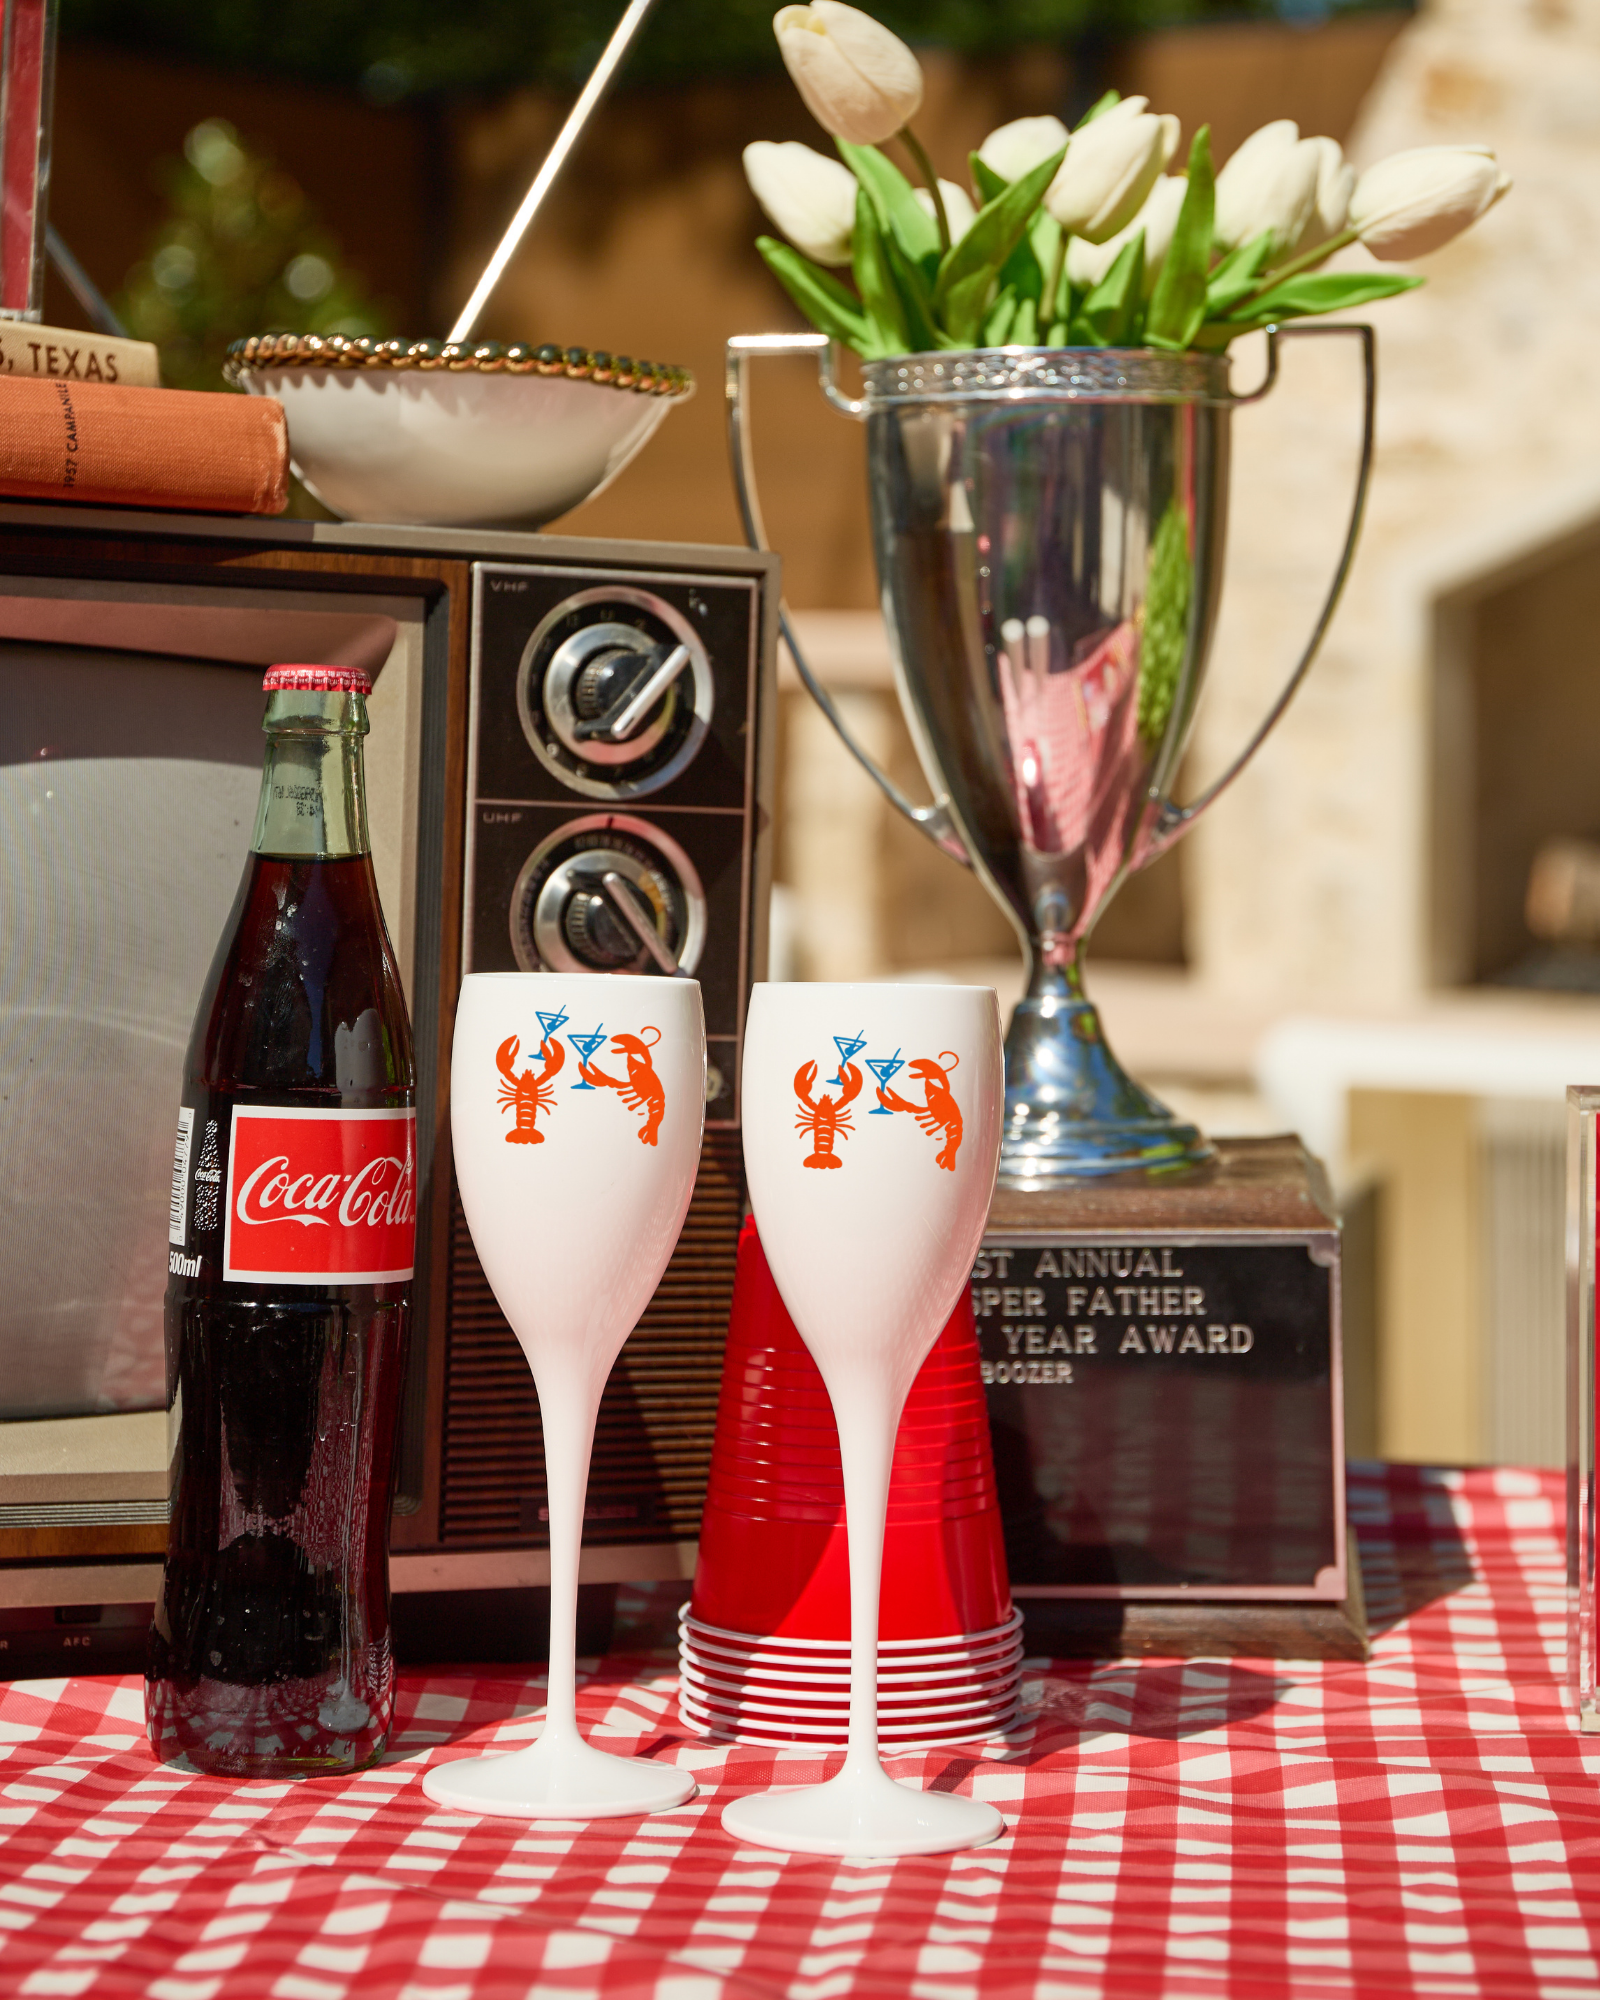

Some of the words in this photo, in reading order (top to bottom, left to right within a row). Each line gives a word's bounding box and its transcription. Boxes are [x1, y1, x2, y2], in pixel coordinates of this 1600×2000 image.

[27, 342, 118, 383] TEXAS
[55, 382, 79, 451] CAMPANILE
[63, 459, 78, 488] 1957
[490, 580, 530, 592] VHF
[483, 812, 524, 824] UHF
[236, 1156, 414, 1227] Coca-Cola
[169, 1251, 202, 1277] 500ml
[1034, 1249, 1184, 1279] ANNUAL
[1066, 1286, 1207, 1317] FATHER
[1000, 1324, 1099, 1355] YEAR
[1118, 1323, 1255, 1355] AWARD
[981, 1360, 1075, 1385] BOOZER
[62, 1636, 92, 1647] AFC
